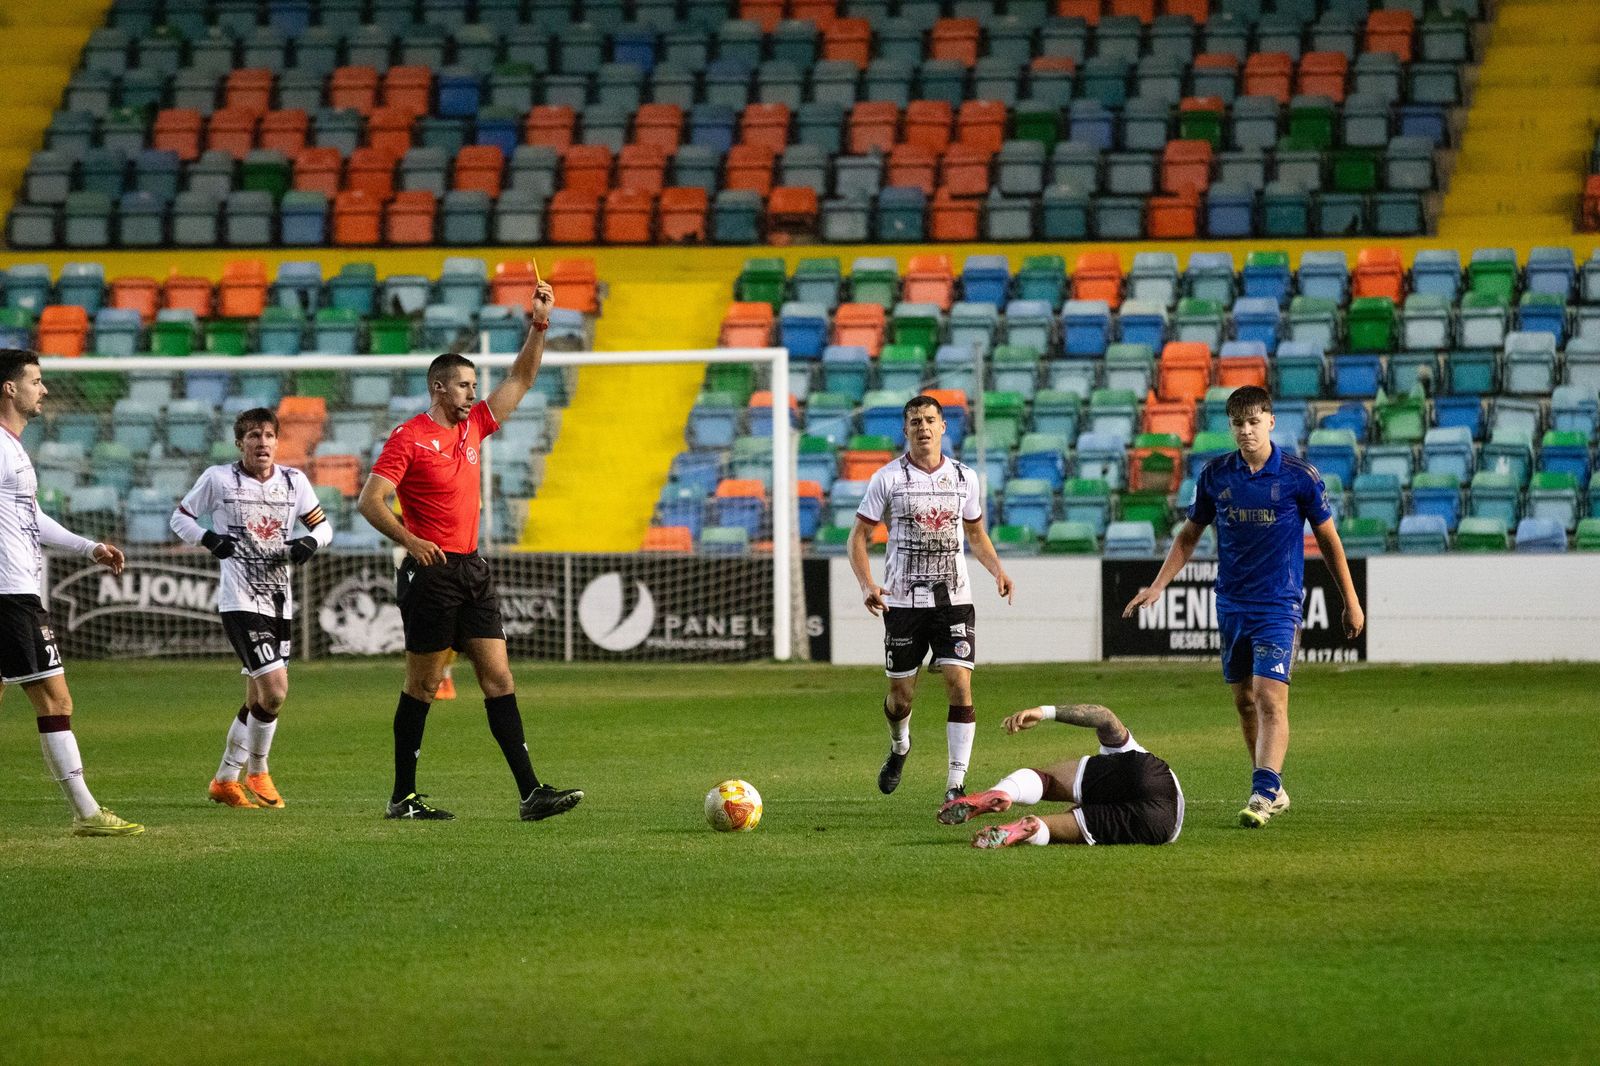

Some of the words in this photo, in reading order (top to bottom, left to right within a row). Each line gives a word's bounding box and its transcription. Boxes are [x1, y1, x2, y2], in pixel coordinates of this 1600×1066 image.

[1239, 508, 1277, 522] INTEGRA
[253, 642, 275, 665] 10
[886, 650, 894, 670] 6
